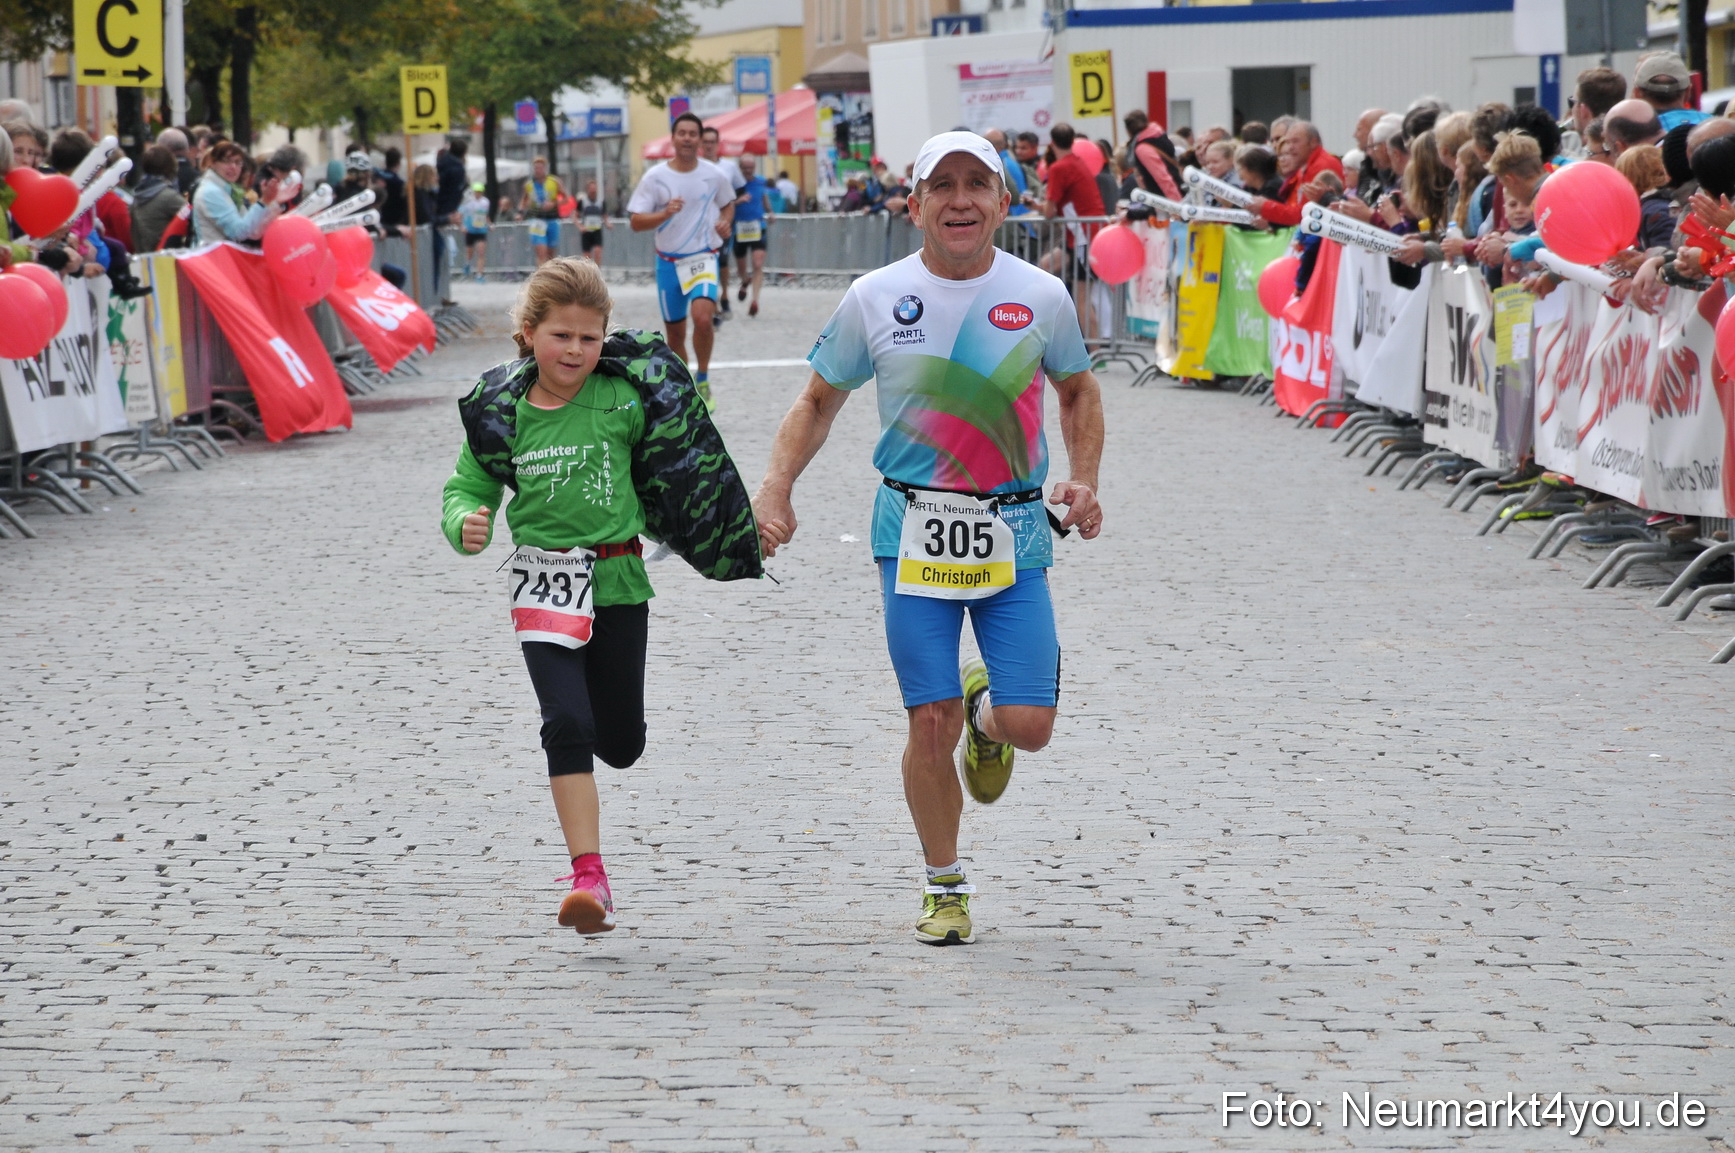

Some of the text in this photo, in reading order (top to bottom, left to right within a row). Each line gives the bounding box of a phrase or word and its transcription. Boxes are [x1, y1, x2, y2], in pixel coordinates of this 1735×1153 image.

[97, 0, 139, 58] C
[1074, 54, 1108, 67] Block
[407, 70, 439, 82] Block
[1082, 72, 1103, 103] D
[415, 87, 436, 118] D
[994, 309, 1029, 324] Hervis
[893, 329, 926, 340] PARTL
[893, 338, 926, 346] Neumarkt
[602, 441, 613, 506] BAMBINI
[909, 500, 941, 513] PARTL
[924, 518, 994, 559] 305
[536, 556, 585, 566] Neumarkt
[904, 550, 909, 558] B
[922, 566, 991, 587] Christoph
[512, 568, 592, 609] 7437
